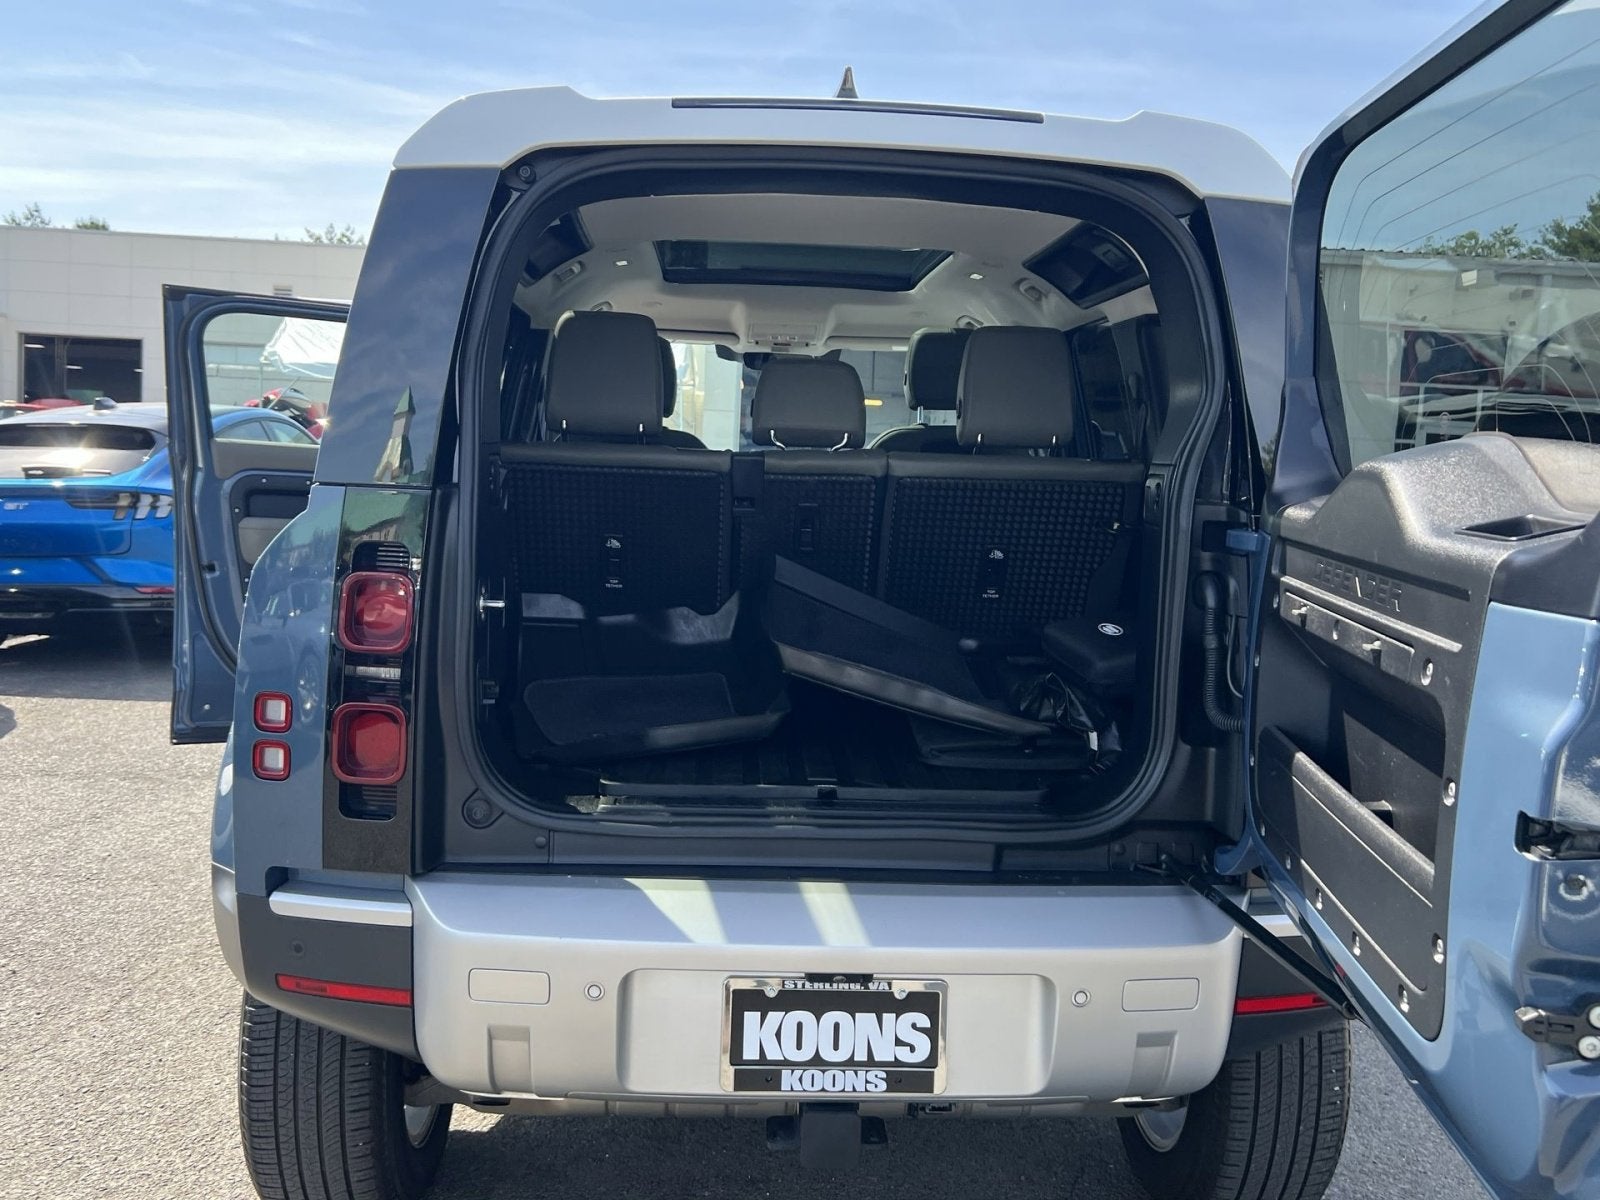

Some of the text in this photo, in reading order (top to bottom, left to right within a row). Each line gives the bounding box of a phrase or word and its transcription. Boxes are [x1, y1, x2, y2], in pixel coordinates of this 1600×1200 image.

[868, 981, 890, 990] VA
[743, 1010, 931, 1063] KOONS
[781, 1069, 887, 1092] KOONS
